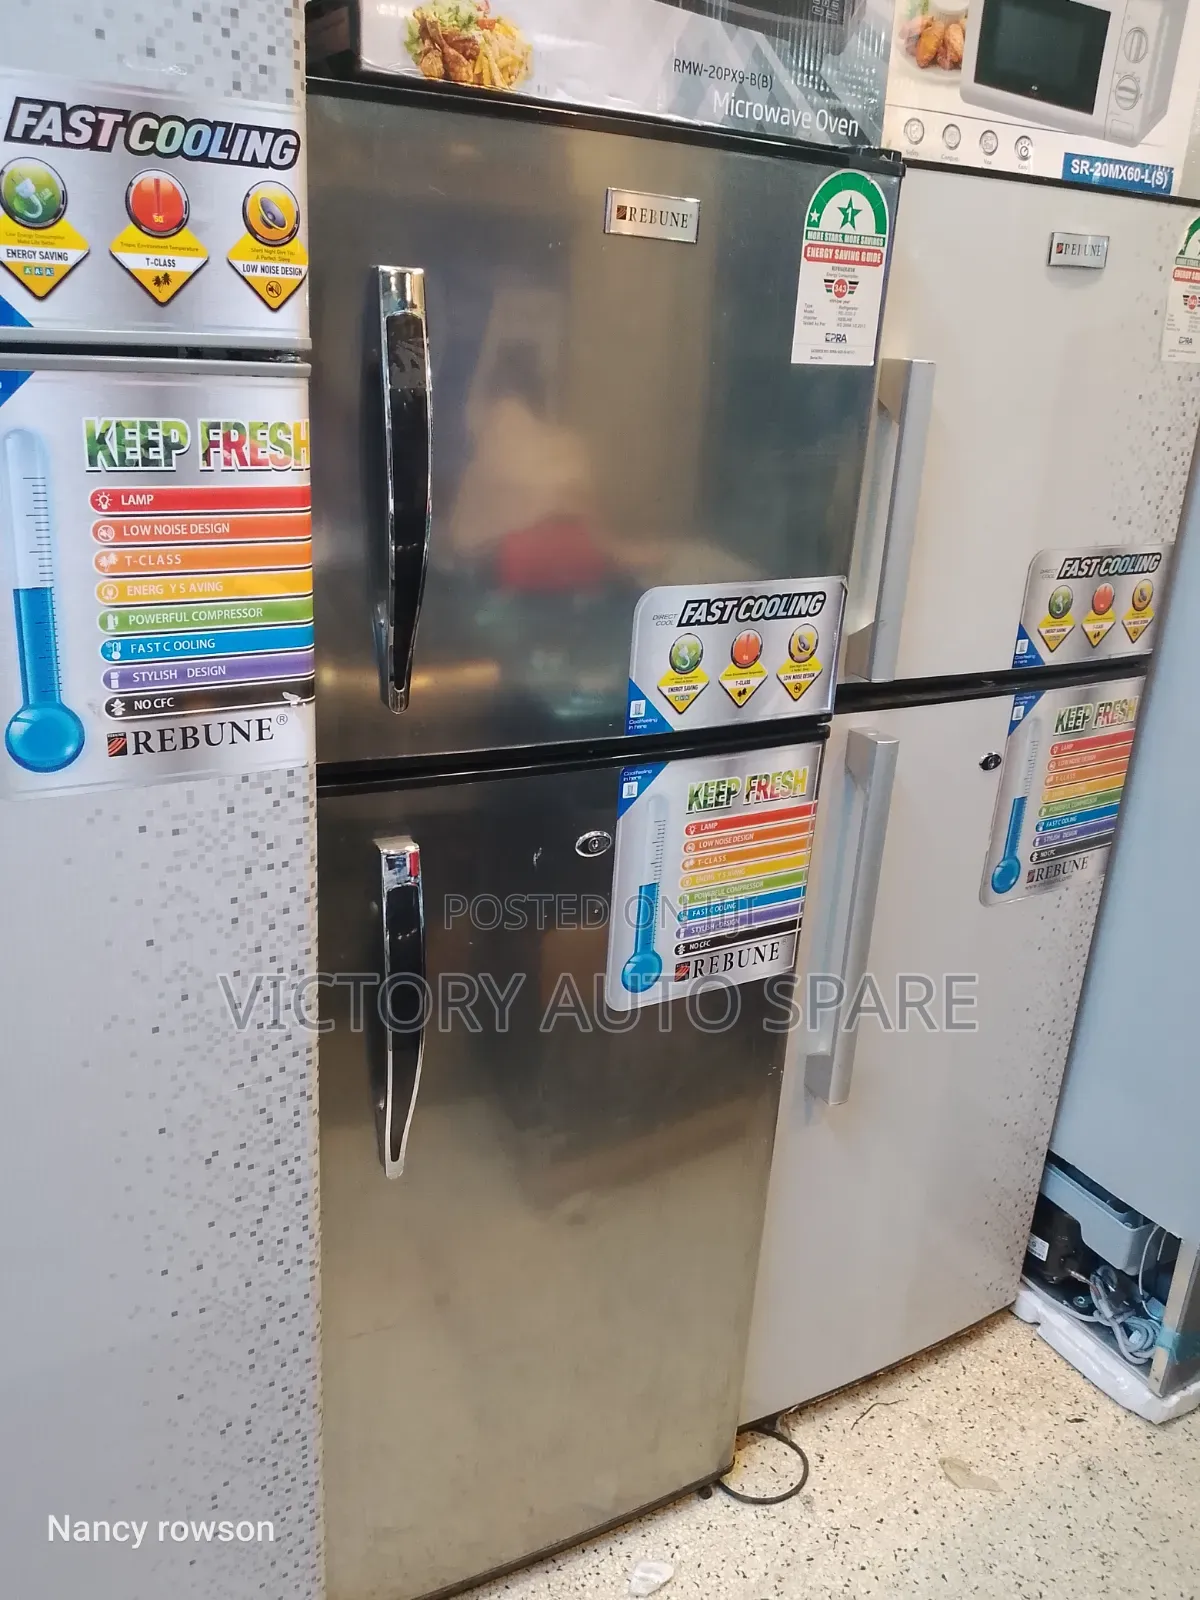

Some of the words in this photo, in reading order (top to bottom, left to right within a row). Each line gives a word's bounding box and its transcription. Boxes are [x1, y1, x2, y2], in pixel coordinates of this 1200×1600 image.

[673, 58, 773, 92] RMW-20PX9-B(B)
[713, 90, 812, 129] Microwave
[816, 109, 859, 137] Oven
[5, 98, 129, 152] FAST
[125, 111, 300, 170] COOLING
[1071, 159, 1168, 189] SR-20MX60-L(S)
[628, 206, 689, 228] REBUNE
[846, 207, 852, 222] 1
[808, 231, 824, 241] MORE
[844, 234, 860, 244] MORE
[6, 248, 37, 260] ENERGY
[38, 250, 69, 261] SAVING
[806, 247, 833, 258] ENERGY
[834, 249, 860, 261] SAVING
[861, 251, 881, 263] GUIDE
[145, 258, 176, 268] T-CLASS
[242, 264, 258, 273] LOW
[260, 265, 280, 274] NOISE
[281, 266, 302, 276] DESIGN
[834, 284, 847, 292] 343
[825, 332, 847, 343] EPRA
[82, 417, 191, 472] KEEP
[198, 418, 310, 472] FRESH
[121, 494, 154, 506] LAMP
[123, 524, 151, 537] LOW
[154, 523, 188, 536] NOISE
[189, 522, 230, 535] DESIGN
[124, 554, 182, 566] T-CLASS
[1056, 556, 1101, 580] FAST
[1097, 552, 1162, 577] COOLING
[129, 611, 189, 626] POWERFUL
[192, 607, 263, 622] COMPRESSOR
[677, 597, 741, 627] FAST
[736, 591, 826, 622] COOLING
[652, 613, 678, 621] DIRECT
[656, 619, 675, 627] COOL
[133, 669, 178, 683] STYLISH
[187, 665, 226, 678] DESIGN
[668, 685, 684, 693] ENERGY
[684, 684, 699, 692] SAVING
[134, 699, 151, 710] NO
[154, 697, 174, 709] CFC
[1053, 704, 1093, 736] KEEP
[1092, 696, 1139, 730] FRESH
[686, 777, 741, 814] KEEP
[744, 766, 809, 805] FRESH
[700, 822, 718, 831] LAMP
[699, 840, 713, 849] LOW
[714, 836, 732, 846] NOISE
[732, 833, 755, 843] DESIGN
[698, 855, 727, 865] T-CLASS
[1035, 856, 1089, 882] REBUNE
[726, 881, 764, 894] COMPRESSOR
[699, 940, 711, 948] CFC
